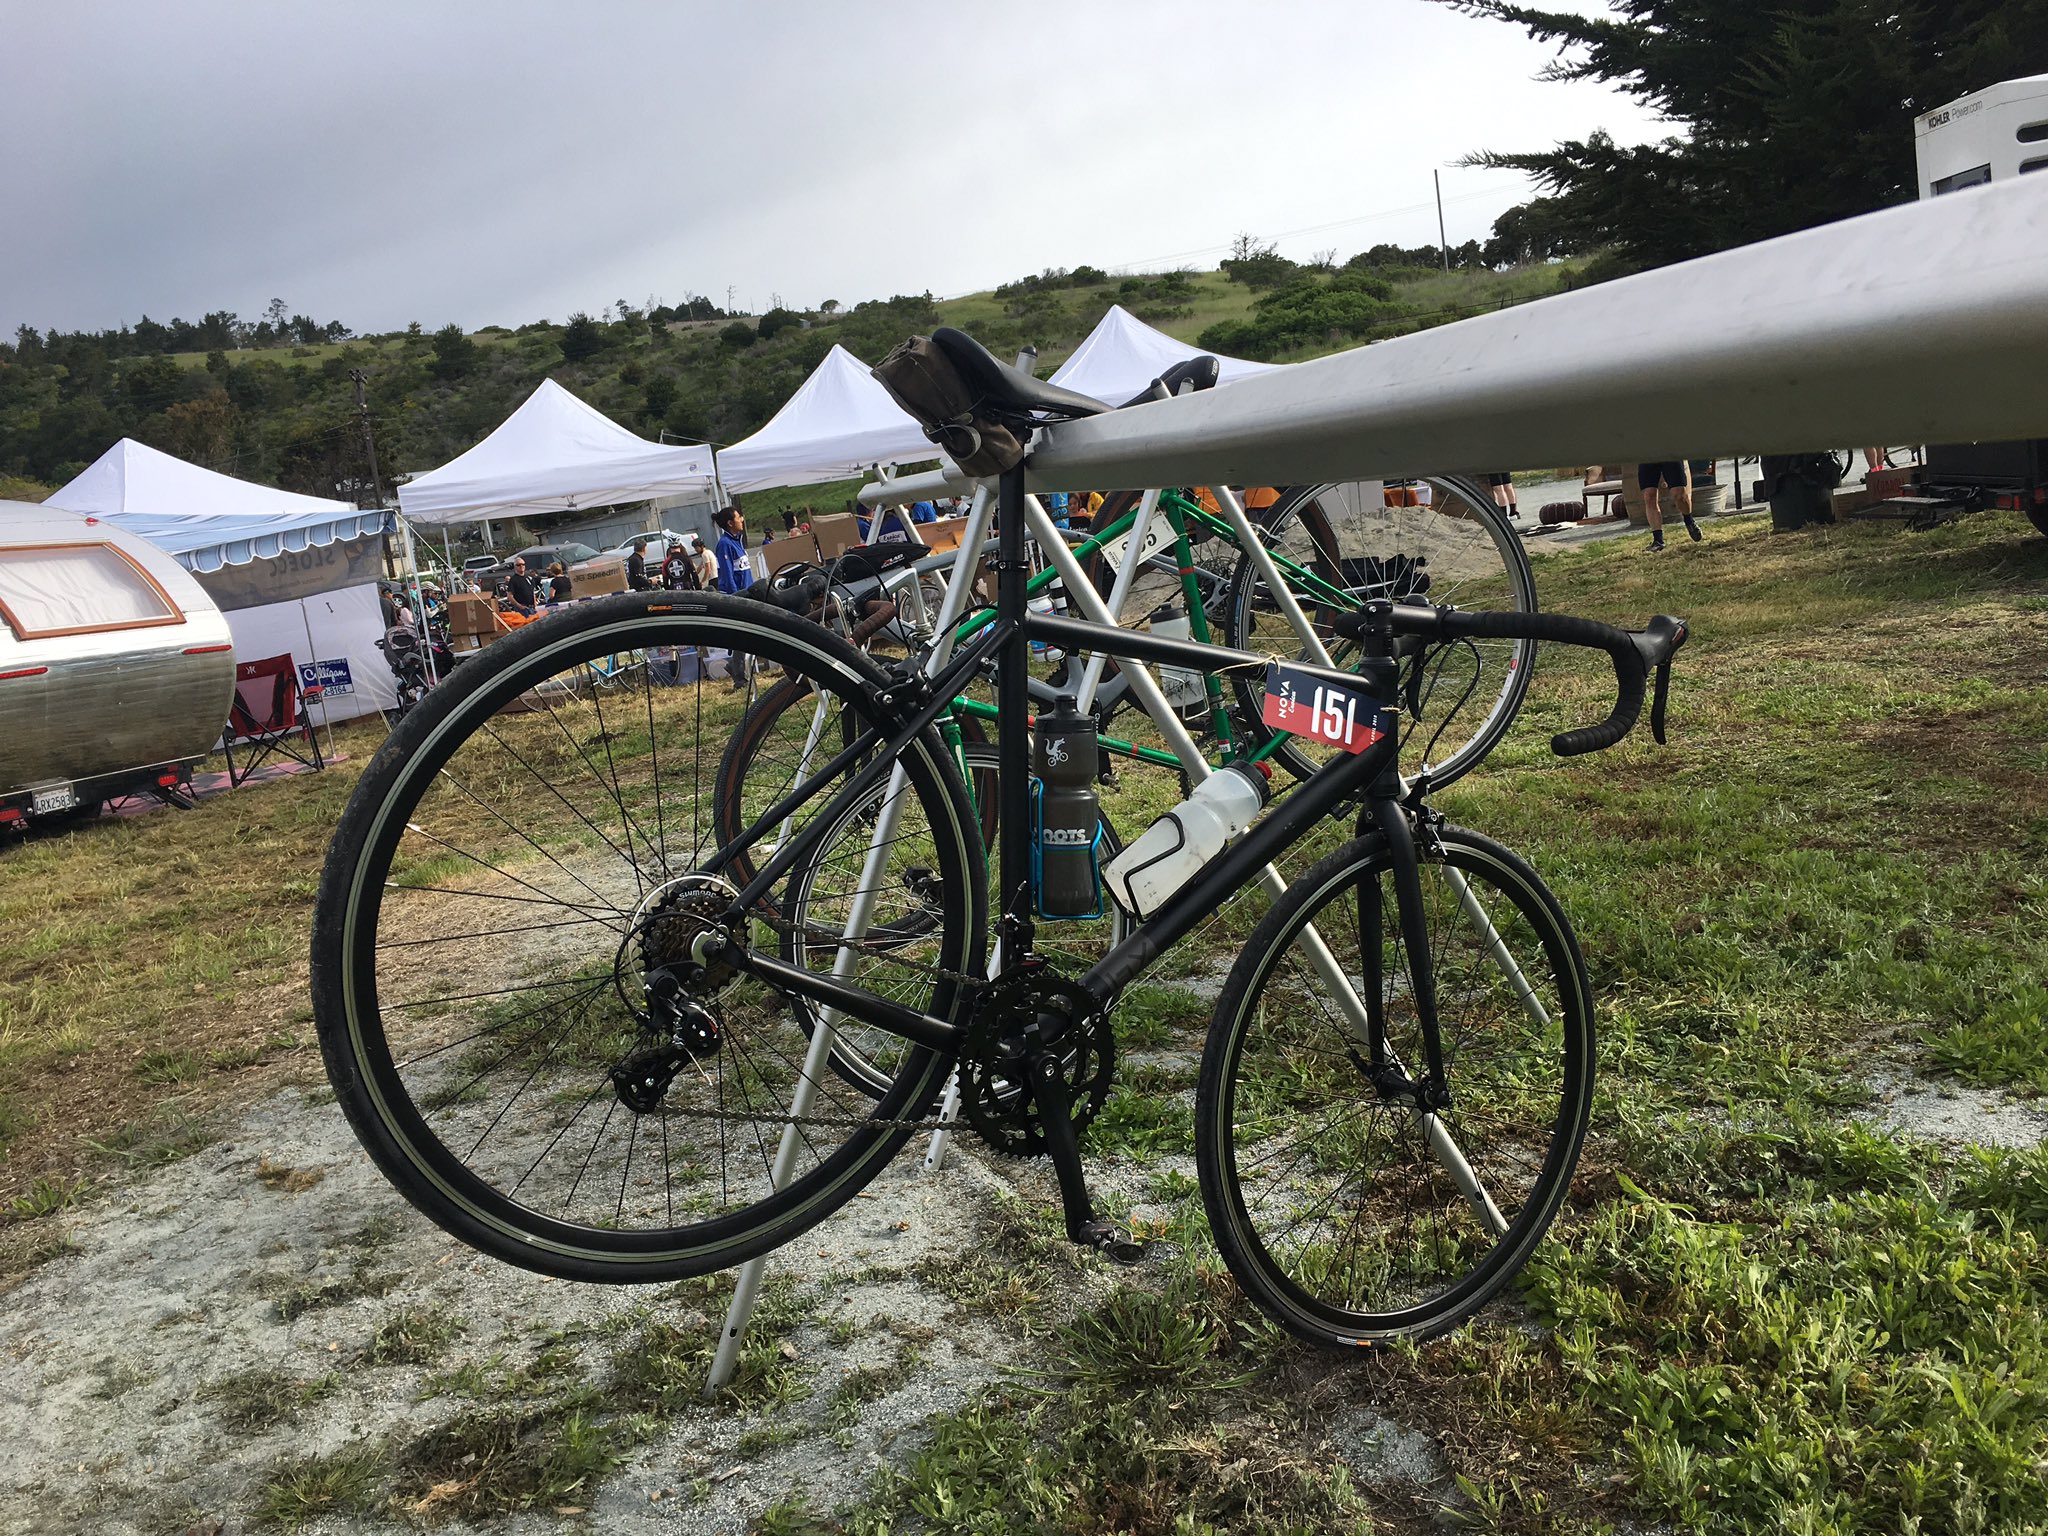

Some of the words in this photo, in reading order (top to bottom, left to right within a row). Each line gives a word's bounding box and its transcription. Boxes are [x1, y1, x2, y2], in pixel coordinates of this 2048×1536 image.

[1928, 112, 1950, 129] KOHLER
[1278, 681, 1290, 719] NOVA
[1311, 686, 1356, 745] 151
[36, 794, 71, 812] 4RX2583
[1043, 828, 1086, 843] OOTS
